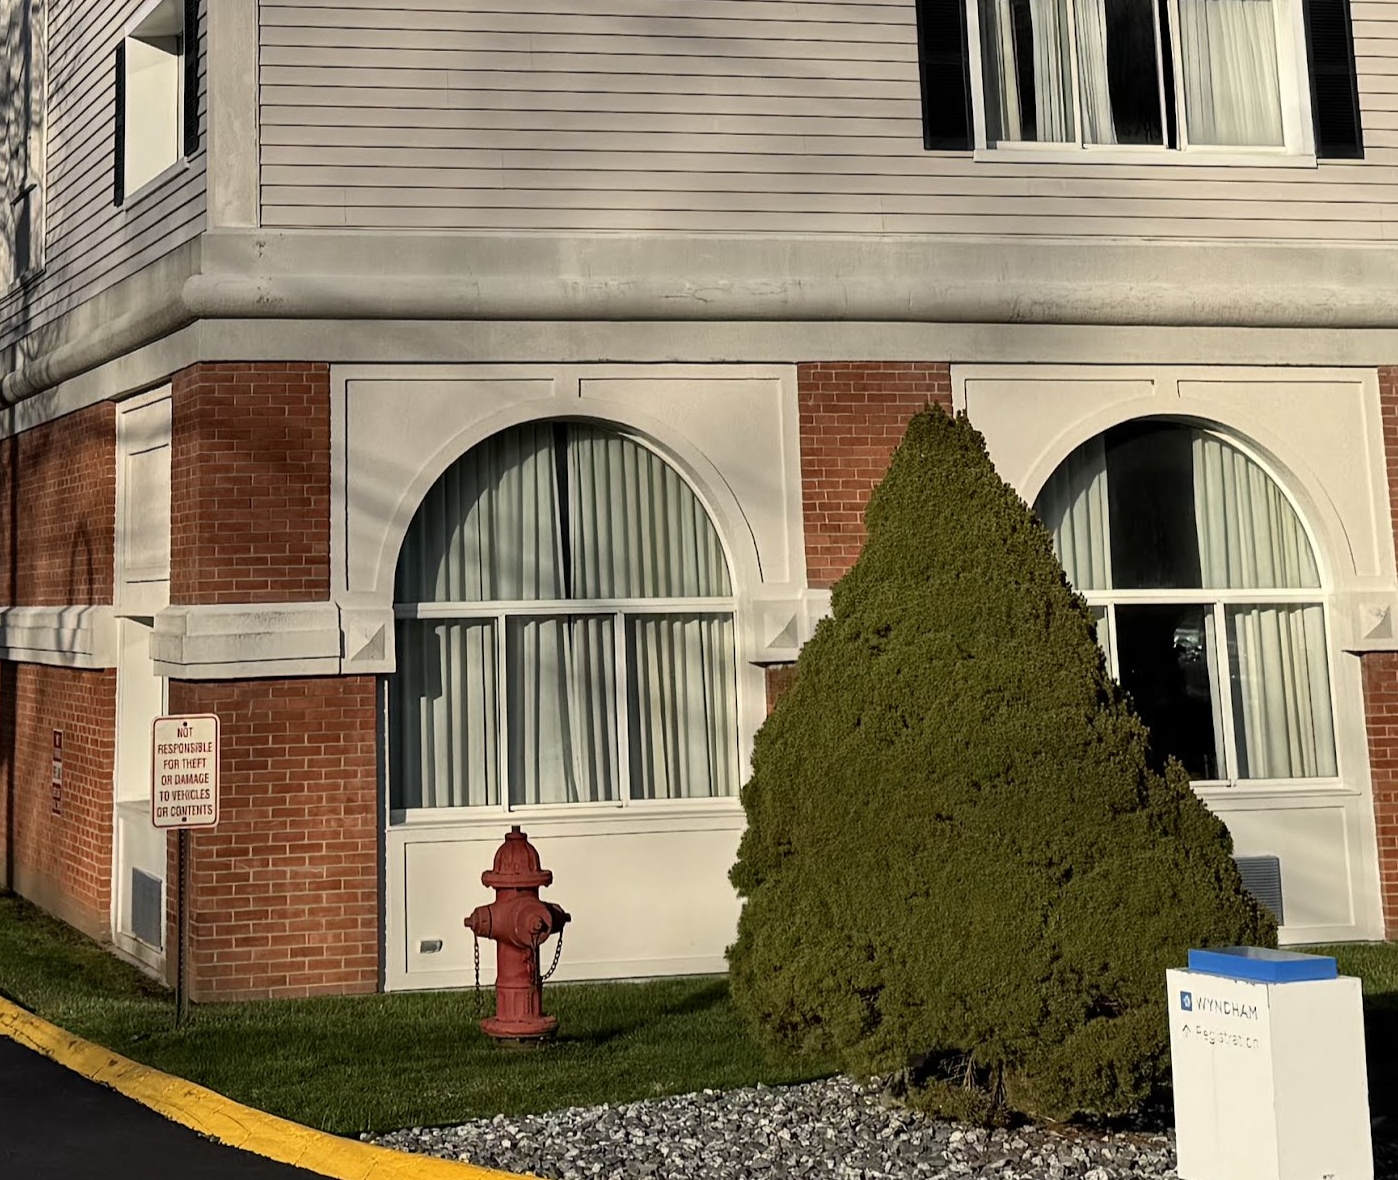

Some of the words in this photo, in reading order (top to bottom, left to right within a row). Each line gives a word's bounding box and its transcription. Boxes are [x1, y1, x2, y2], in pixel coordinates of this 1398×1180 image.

[177, 727, 193, 738] NOT
[158, 742, 213, 754] RESPONSIBLE
[163, 759, 180, 770] FOR
[182, 758, 206, 769] THEFT
[161, 775, 173, 786] OR
[174, 773, 209, 785] DAMAGE
[159, 790, 170, 802] TO
[172, 788, 210, 801] VEHICLES
[156, 806, 168, 818] OR
[170, 804, 213, 817] CONTENTS
[1196, 996, 1258, 1020] WYNDHAM
[1196, 1025, 1258, 1049] Regstraton
